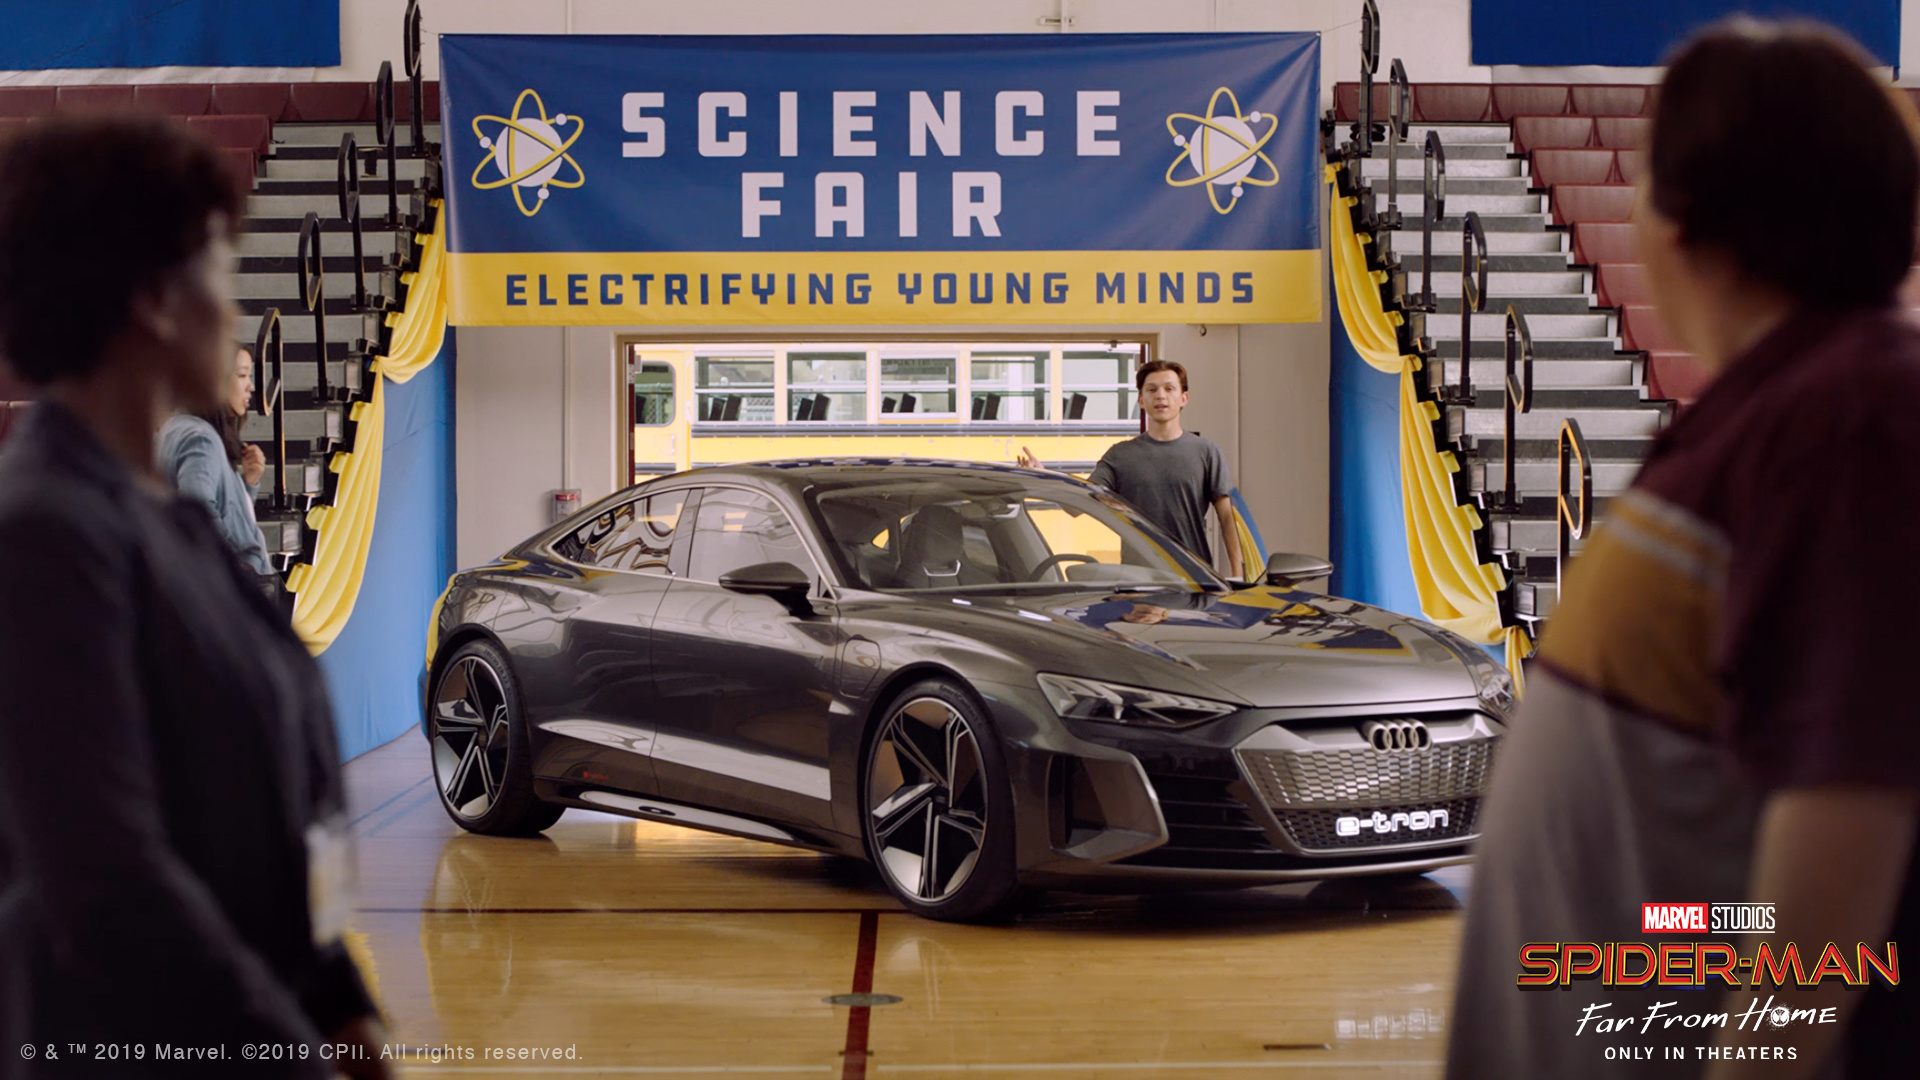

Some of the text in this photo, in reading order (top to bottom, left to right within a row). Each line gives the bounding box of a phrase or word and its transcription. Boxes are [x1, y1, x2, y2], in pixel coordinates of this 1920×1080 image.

[622, 90, 1121, 158] SCIENCE
[741, 171, 1002, 238] FAIR
[505, 271, 1255, 307] ELECTRIFYING YOUNG MINDS
[1336, 810, 1449, 837] e-tron
